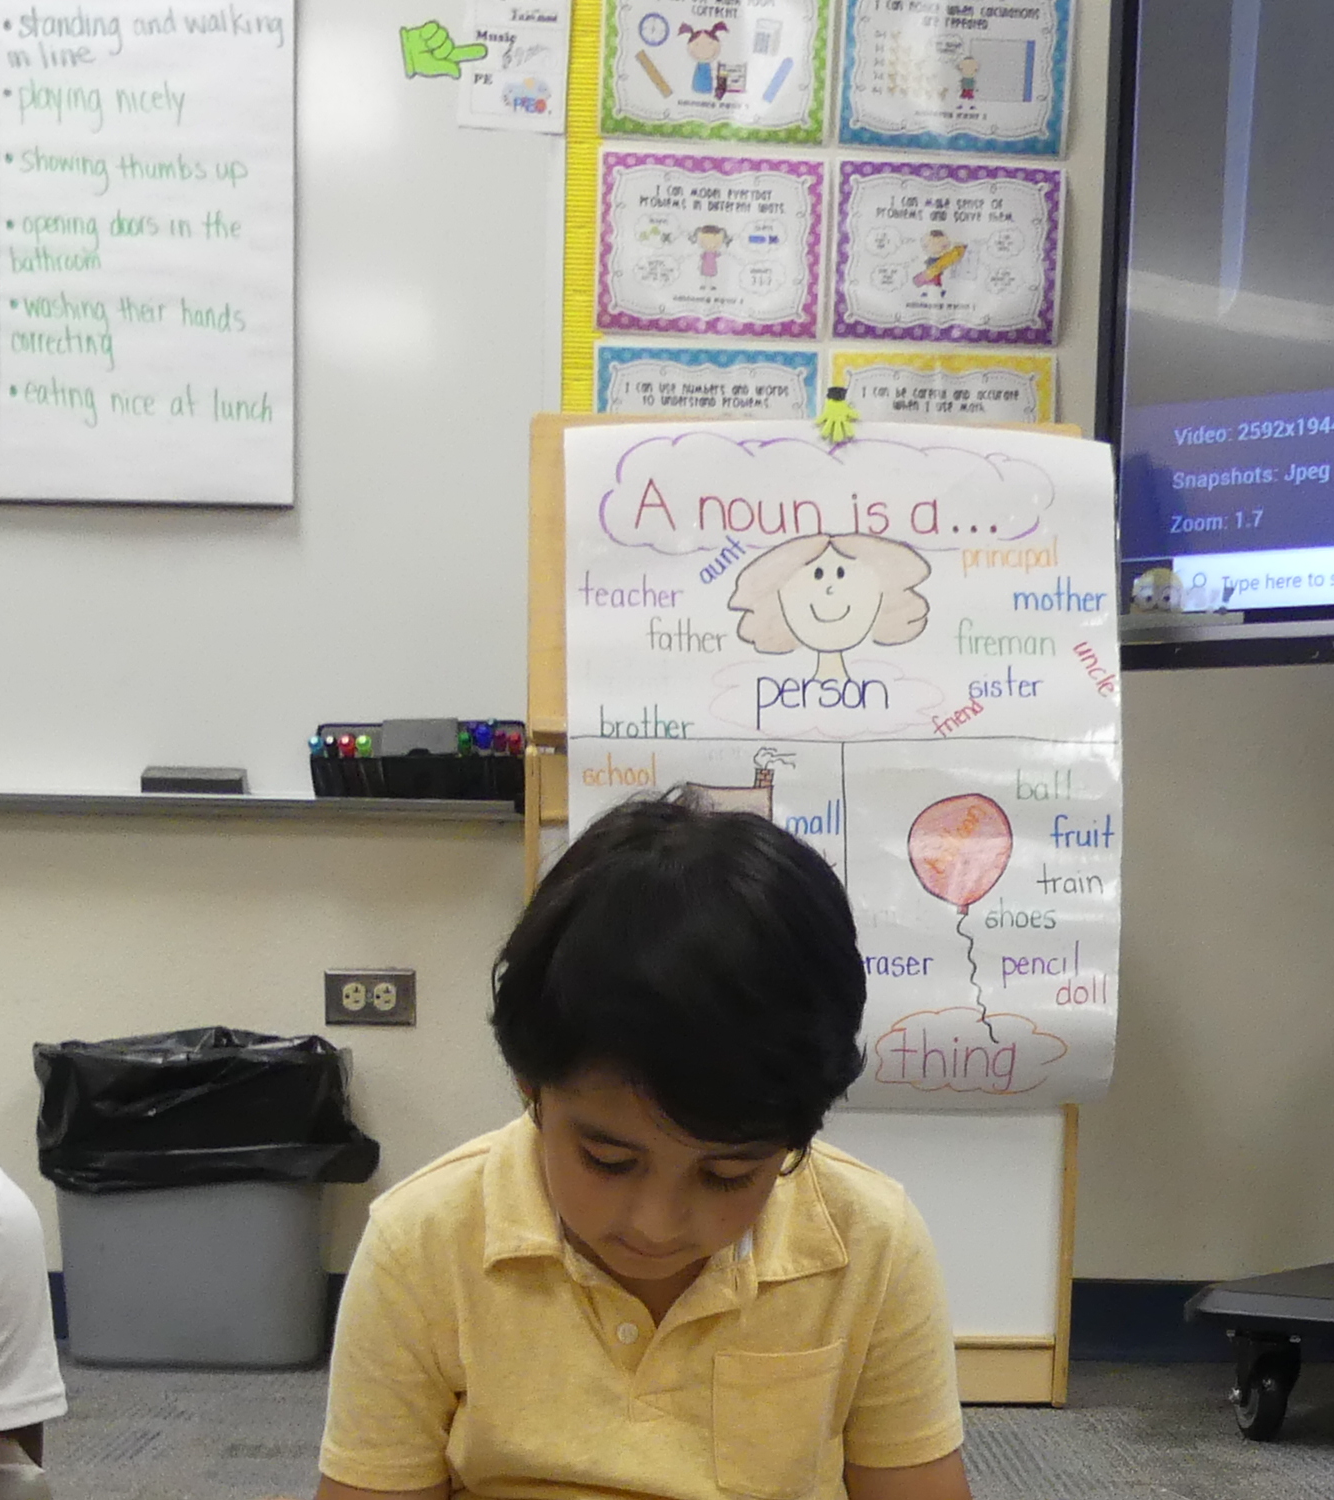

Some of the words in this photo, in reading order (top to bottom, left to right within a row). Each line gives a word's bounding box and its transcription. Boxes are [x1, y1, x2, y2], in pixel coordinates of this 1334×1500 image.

[18, 5, 124, 56] standing
[133, 6, 176, 36] and
[183, 3, 285, 48] walking
[476, 30, 517, 43] Music
[7, 50, 30, 69] in
[38, 41, 96, 69] line
[18, 78, 104, 134] playing
[116, 80, 186, 127] nicely
[116, 154, 207, 181] thumbs
[216, 160, 248, 188] up
[22, 215, 99, 250] opening
[109, 209, 160, 238] doors
[170, 218, 191, 238] in
[204, 210, 242, 240] the
[9, 245, 102, 274] bathroom
[23, 291, 109, 333] washing
[118, 296, 167, 323] their
[181, 297, 246, 333] hands
[11, 325, 115, 373] correcting
[24, 376, 98, 428] eating
[111, 391, 155, 416] nice
[171, 382, 195, 418] at
[214, 388, 273, 423] lunch
[1174, 426, 1233, 446] Video:
[1172, 466, 1279, 491] Snapshots:
[1284, 463, 1331, 485] Jpeg
[634, 478, 677, 532] A
[698, 495, 822, 534] noun
[851, 493, 890, 534] is
[1170, 514, 1229, 534] Zoom:
[1235, 507, 1264, 529] 1.7
[698, 535, 749, 585] aunt
[961, 537, 1059, 573] principal
[578, 569, 685, 608] teacher
[1013, 576, 1107, 612] mother
[1222, 575, 1259, 595] Type
[1265, 573, 1302, 590] here
[1308, 572, 1325, 588] to
[645, 619, 728, 655] father
[954, 620, 1056, 657] fireman
[968, 665, 1044, 700] sister
[1072, 638, 1116, 698] uncle
[756, 674, 889, 731] person
[930, 697, 984, 739] friend
[599, 704, 695, 740] brother
[582, 753, 658, 788] school
[1016, 768, 1073, 802] ball
[785, 798, 841, 836] mall
[1050, 814, 1116, 849] fruit
[1036, 862, 1104, 895] train
[984, 896, 1057, 931] shoes
[860, 955, 934, 978] raser
[1001, 941, 1080, 988] pencil
[1054, 969, 1107, 1006] doll
[891, 1027, 1017, 1093] thing
